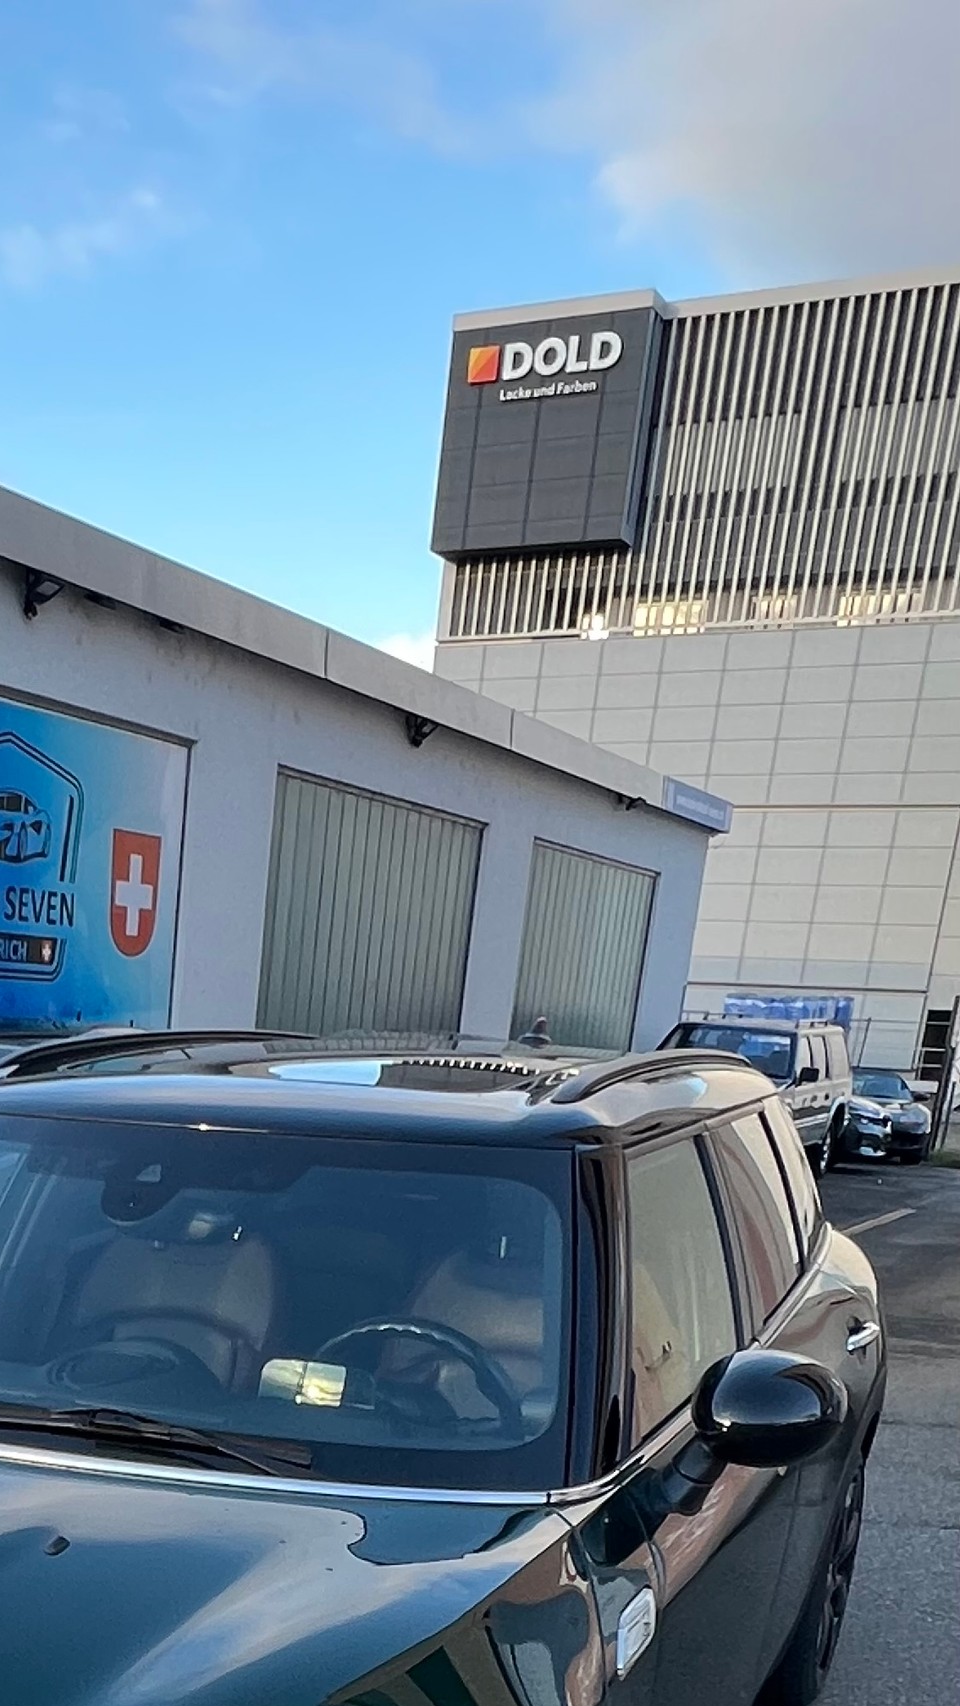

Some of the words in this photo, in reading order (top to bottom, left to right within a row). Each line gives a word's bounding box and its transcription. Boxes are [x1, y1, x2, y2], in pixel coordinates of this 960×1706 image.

[501, 331, 623, 381] DOLD
[499, 387, 532, 402] Lacke
[533, 382, 556, 398] und
[556, 380, 597, 395] Farben
[3, 885, 75, 927] SEVEN
